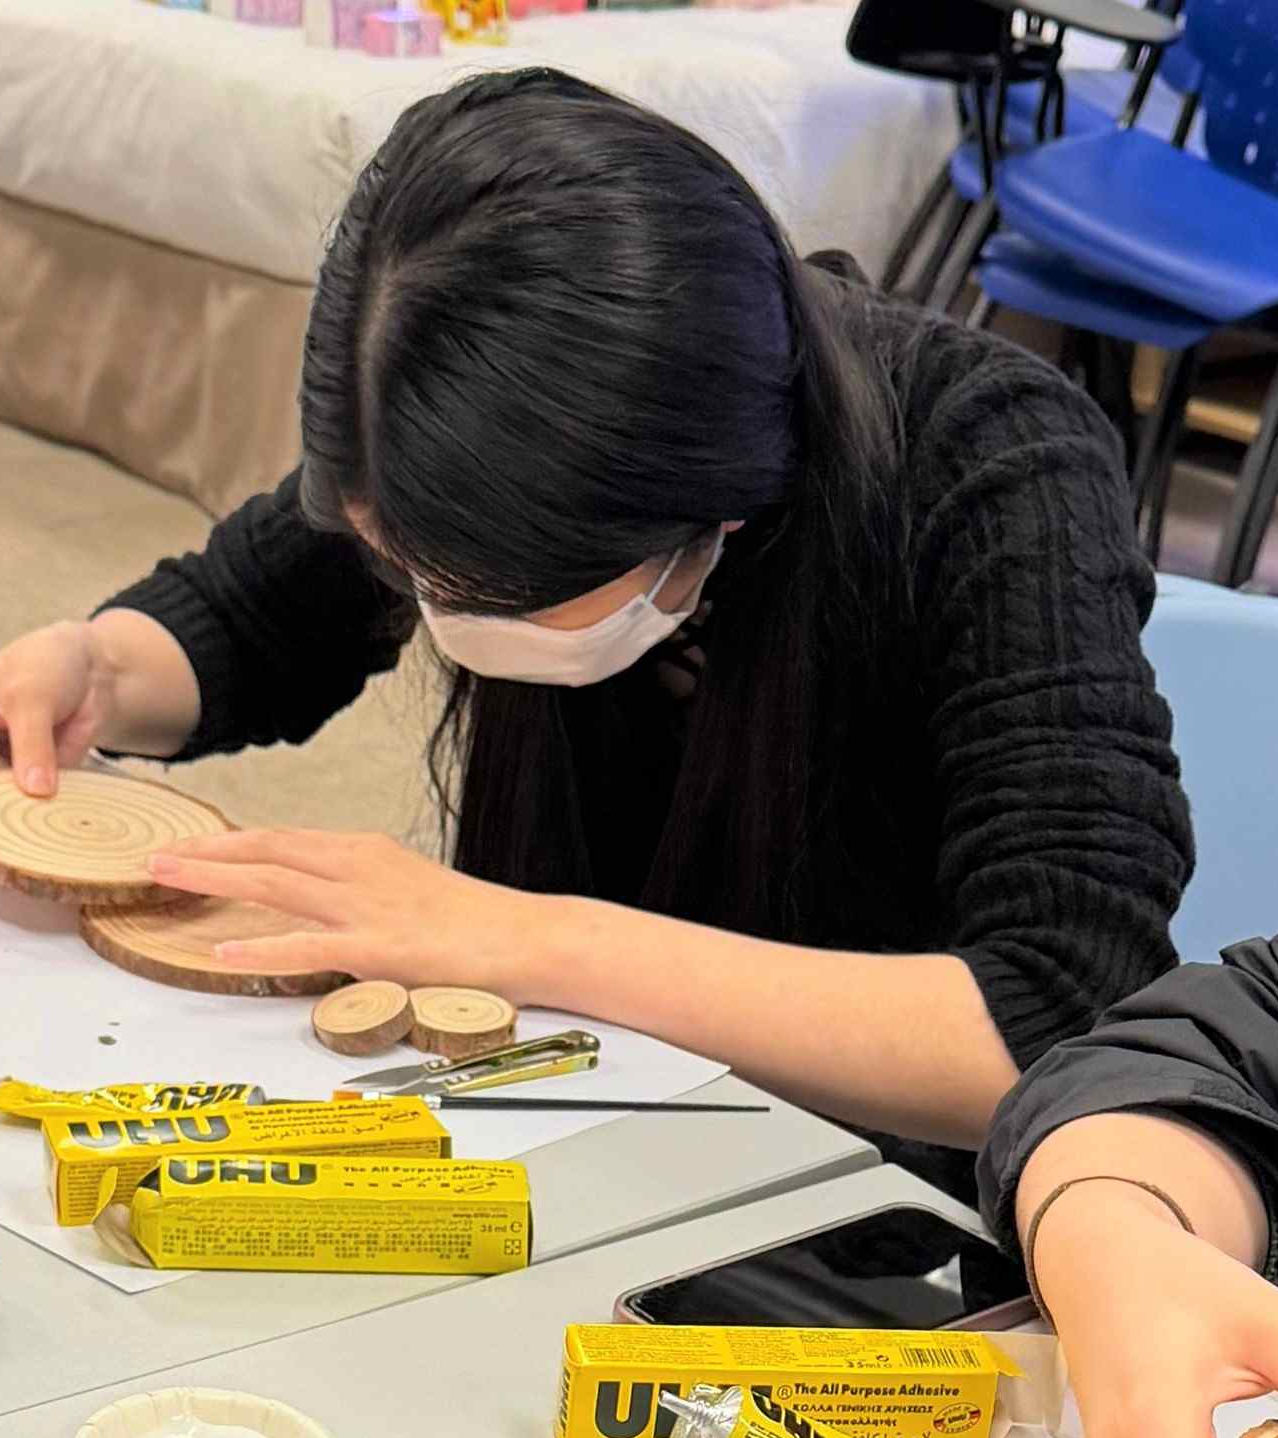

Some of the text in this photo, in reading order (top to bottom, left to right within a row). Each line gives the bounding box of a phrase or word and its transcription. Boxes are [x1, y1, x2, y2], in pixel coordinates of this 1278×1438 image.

[68, 1115, 231, 1148] UHU
[168, 1158, 317, 1186] UHU
[794, 1383, 960, 1398] The All Purpose Adhesive
